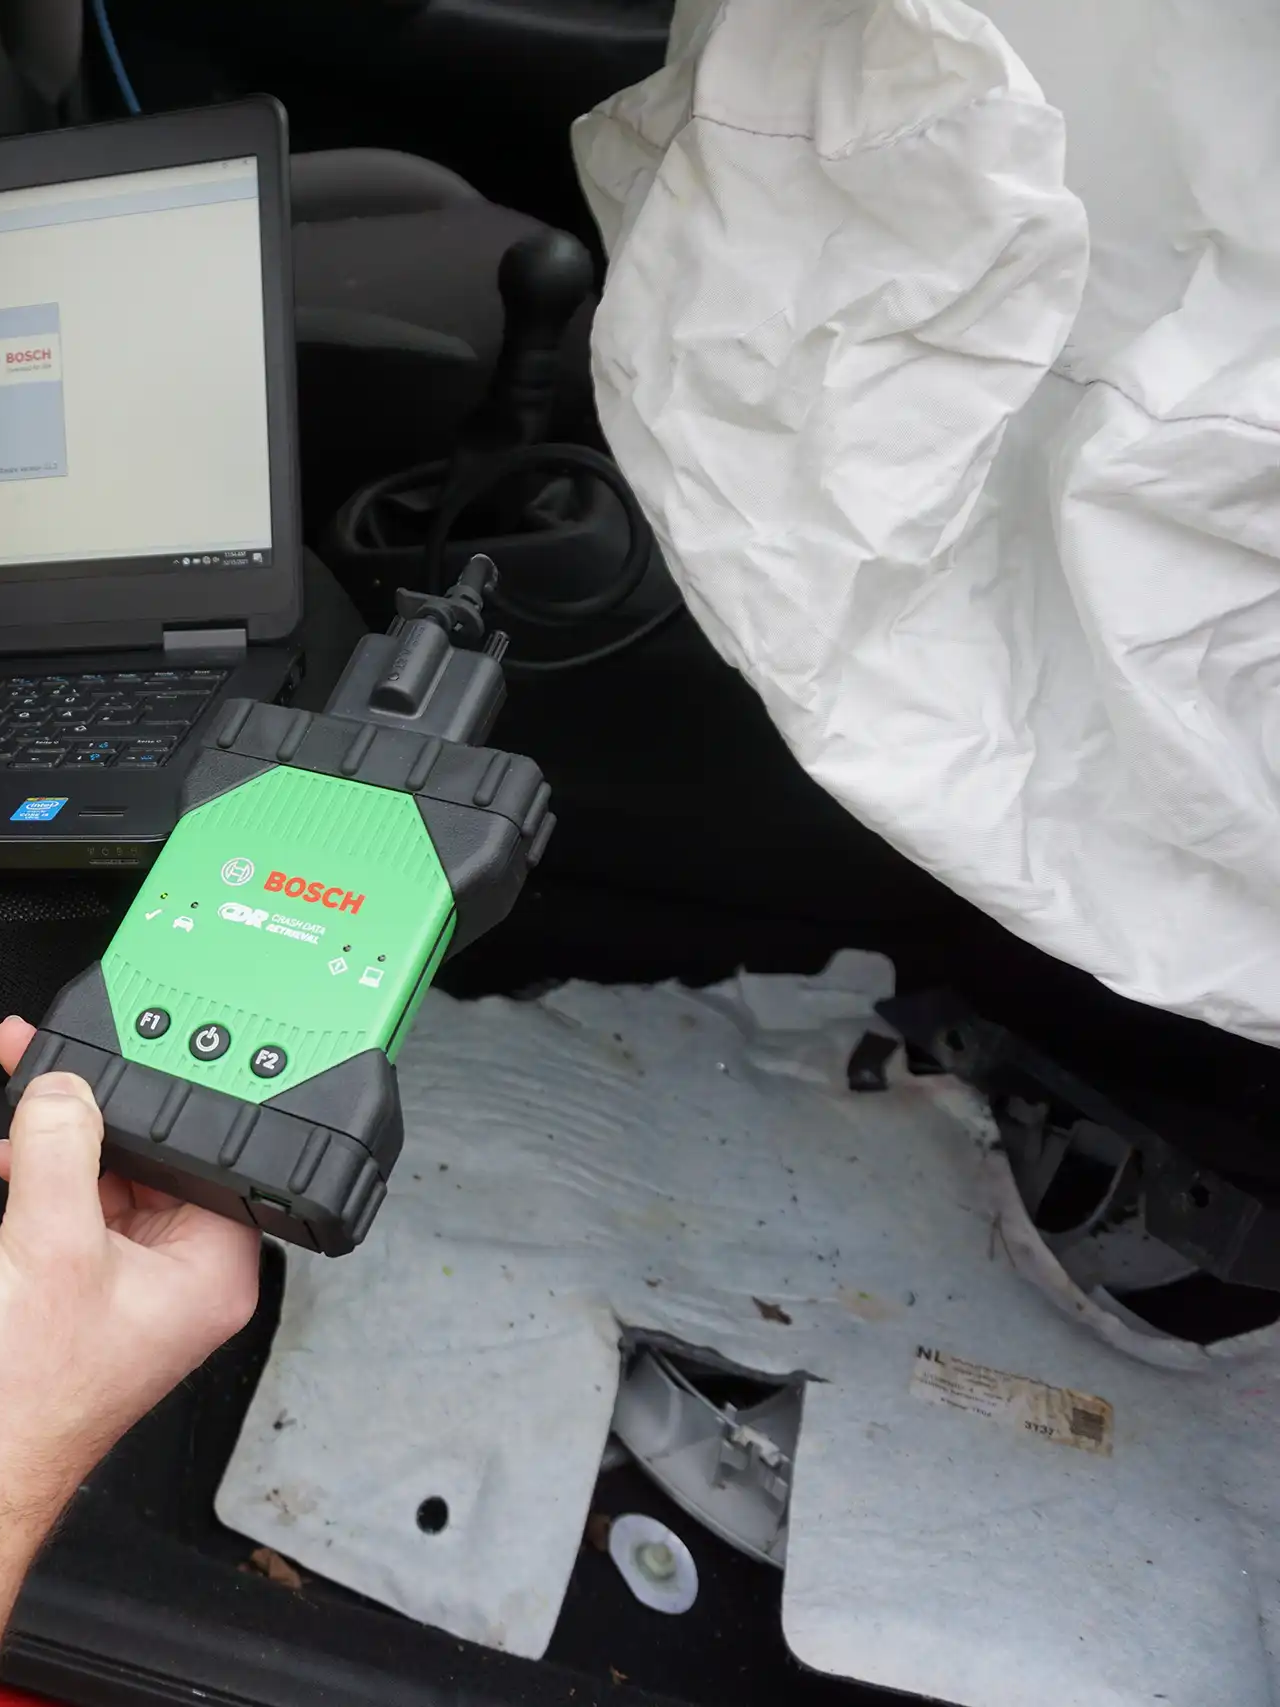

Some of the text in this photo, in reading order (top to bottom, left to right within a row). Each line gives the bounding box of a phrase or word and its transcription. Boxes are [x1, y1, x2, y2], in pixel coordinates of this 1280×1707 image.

[5, 348, 52, 364] BOSCH
[263, 871, 366, 915] BOSCH
[265, 923, 320, 945] RETRIEVAL
[271, 913, 326, 935] CRASH DATA
[139, 1011, 161, 1031] F1
[255, 1050, 280, 1070] F2
[915, 1345, 947, 1366] NL
